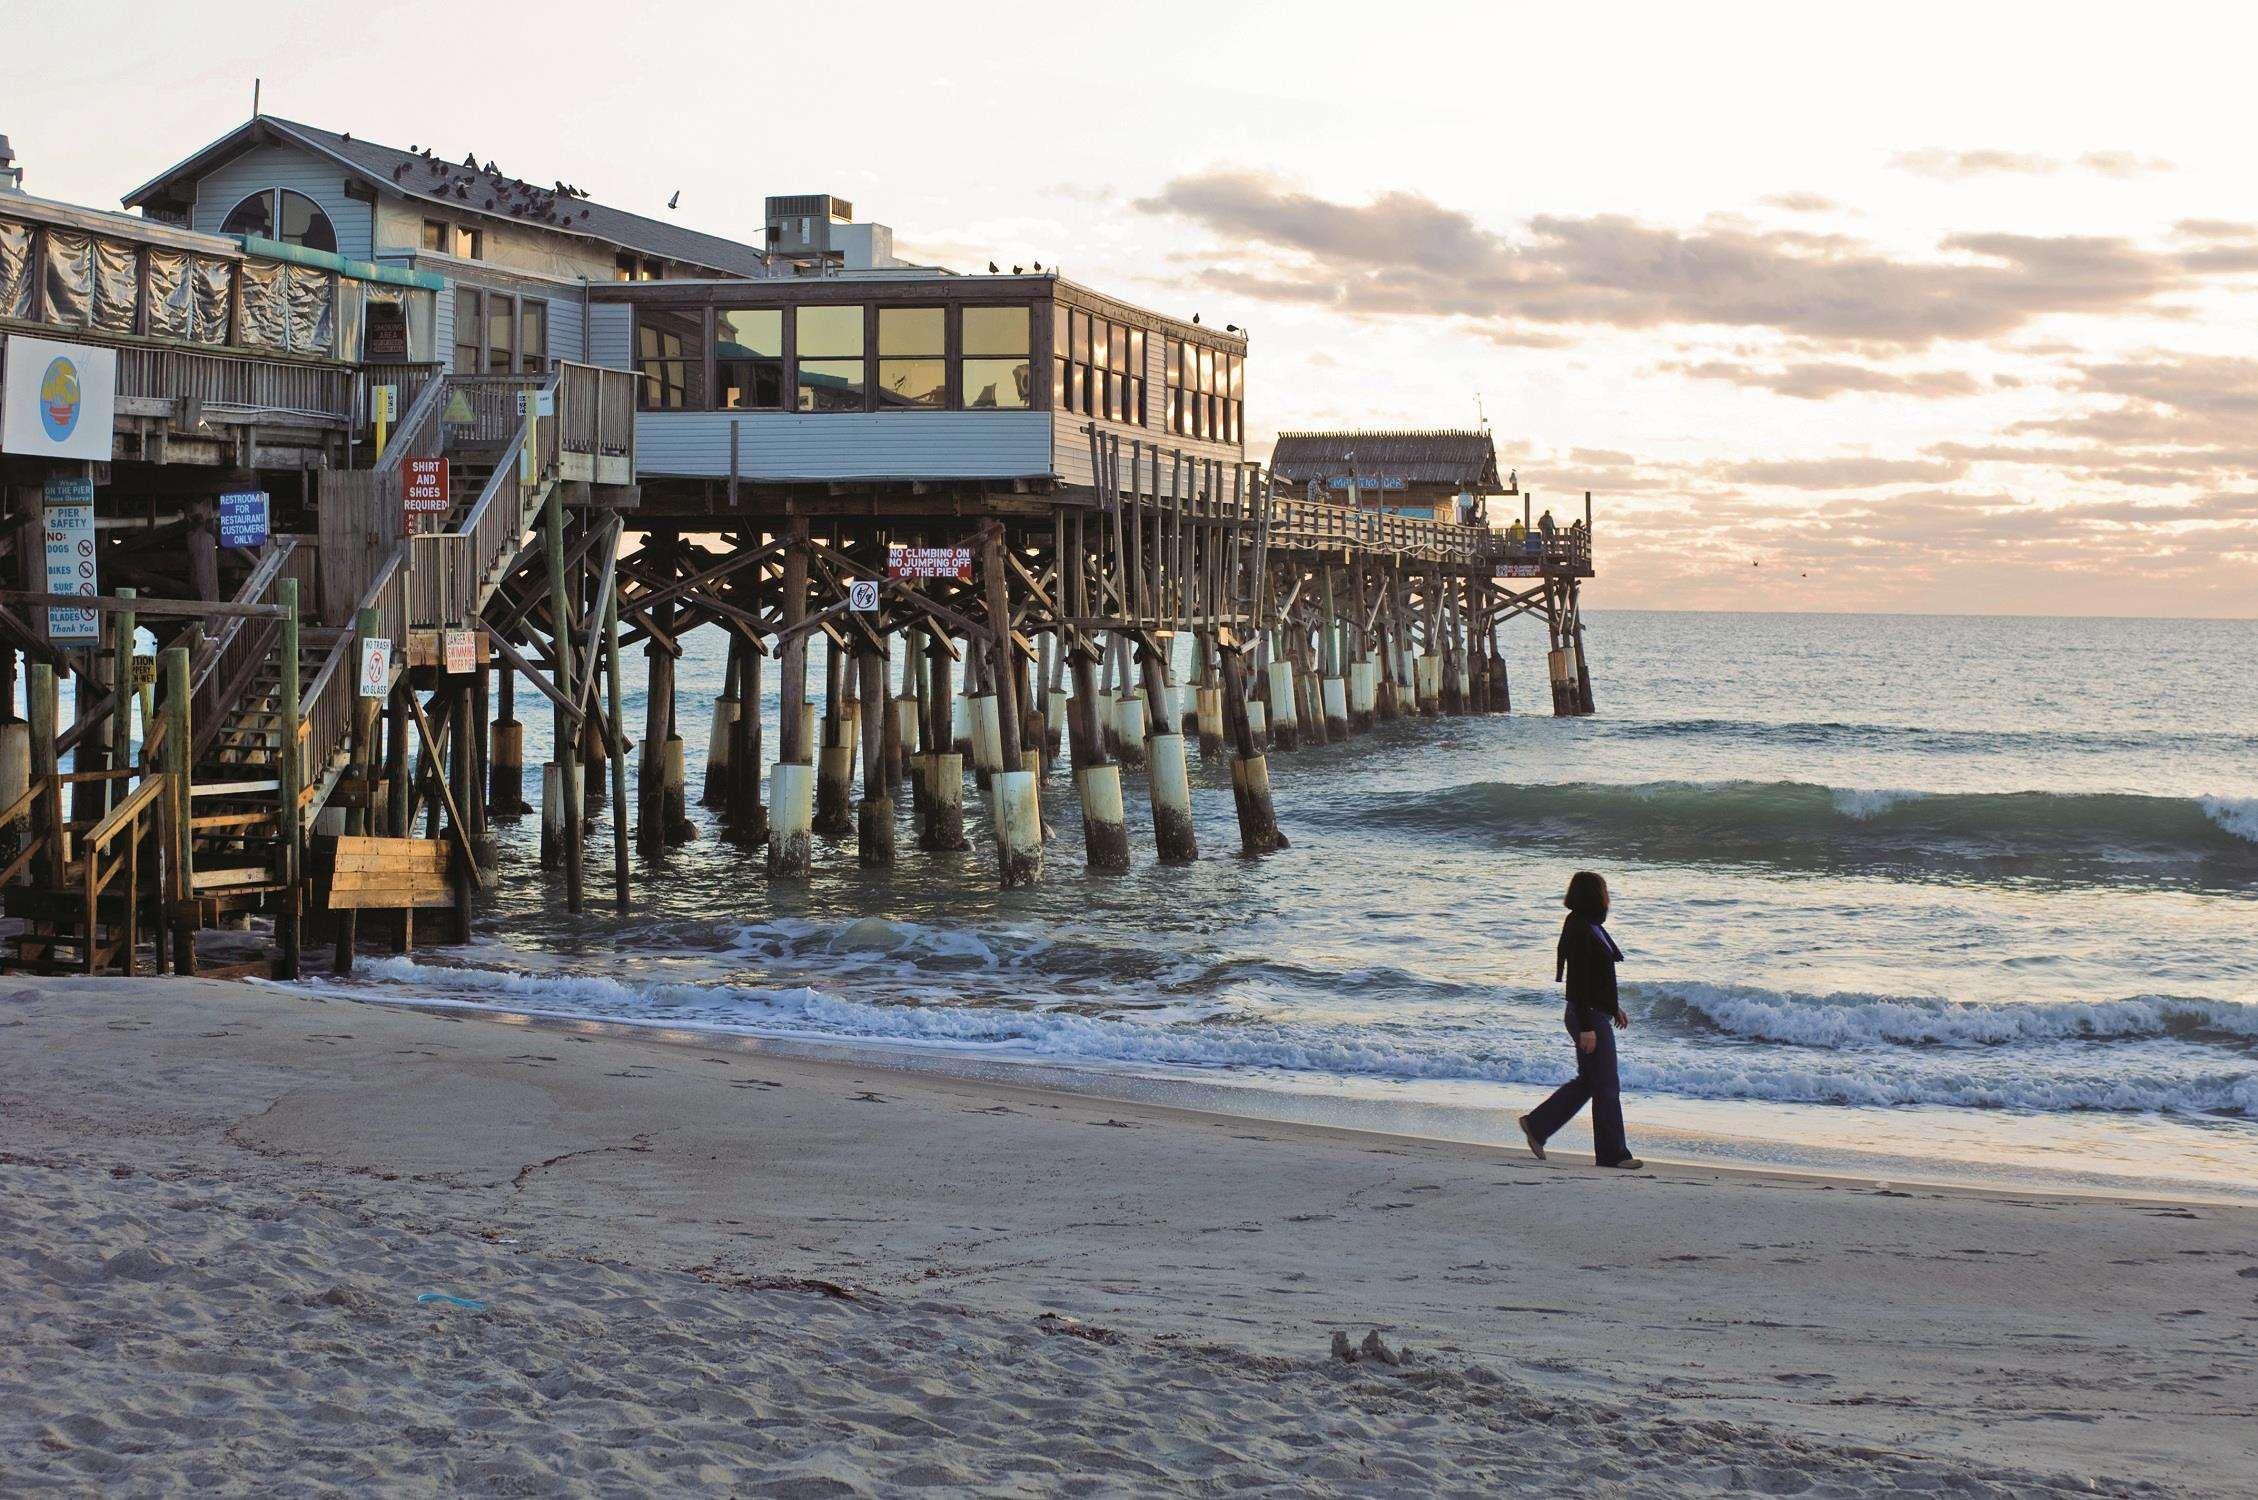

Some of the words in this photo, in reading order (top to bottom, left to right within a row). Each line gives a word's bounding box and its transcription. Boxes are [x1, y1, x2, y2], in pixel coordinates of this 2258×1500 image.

[412, 461, 440, 472] SHIRT
[416, 474, 436, 485] AND
[45, 487, 56, 496] ON
[57, 486, 72, 495] THE
[73, 485, 91, 495] PIER
[409, 486, 441, 498] SHOES
[235, 504, 250, 514] FOR
[404, 499, 448, 511] REQUIRED
[57, 508, 80, 518] PIER
[50, 519, 87, 528] SAFETY
[221, 514, 264, 524] RESTAURANT
[221, 524, 264, 534] CUSTOMERS
[47, 532, 66, 541] NO:
[234, 534, 253, 545] ONLY
[47, 544, 70, 553] DOGS
[889, 548, 903, 558] NO
[905, 548, 954, 558] CLIMBING
[956, 548, 970, 558] ON
[889, 558, 902, 568] NO
[904, 558, 950, 568] JUMPING
[952, 558, 971, 567] OFF
[48, 566, 72, 575] BIKES
[900, 567, 912, 577] OF
[915, 567, 935, 577] THE
[936, 567, 959, 577] PIER
[53, 582, 74, 592] SURF
[49, 612, 80, 622] BLADES
[52, 623, 76, 633] Thank
[79, 624, 94, 632] You
[365, 640, 373, 650] NO
[374, 640, 390, 651] TRASH
[447, 646, 475, 658] SWIMMING
[362, 684, 370, 695] NO
[370, 684, 388, 696] GLASS
